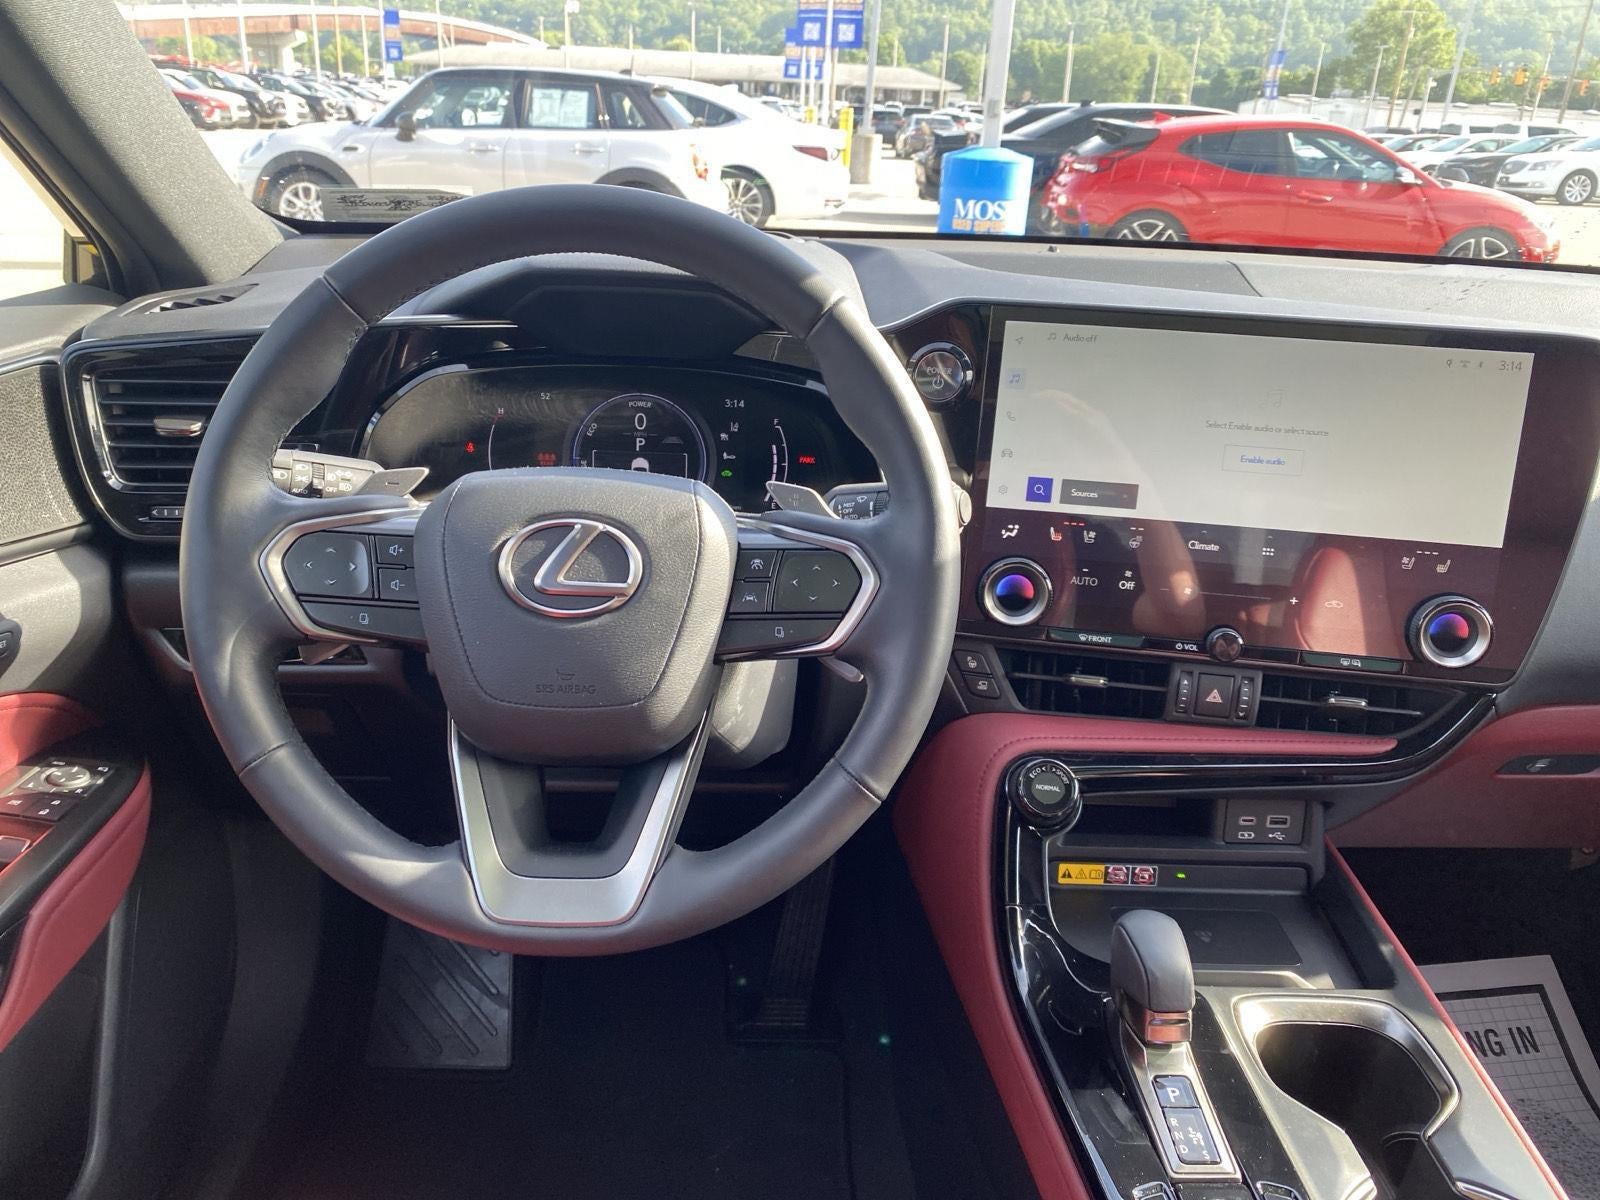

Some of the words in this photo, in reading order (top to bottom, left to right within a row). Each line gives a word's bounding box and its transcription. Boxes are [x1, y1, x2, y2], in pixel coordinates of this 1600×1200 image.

[1063, 333, 1085, 342] Audio
[1086, 335, 1097, 343] off
[1499, 360, 1522, 371] 3:14
[926, 366, 953, 376] POWER
[540, 392, 551, 400] 52
[628, 401, 652, 409] POWER
[724, 399, 745, 408] 3:14
[498, 407, 504, 415] H
[634, 412, 647, 431] 0
[586, 422, 598, 437] ECO
[1205, 420, 1228, 430] Select
[1228, 422, 1253, 431] Enable
[1283, 427, 1305, 435] select
[635, 437, 646, 452] P
[1239, 454, 1265, 465] Enable
[1265, 458, 1286, 466] audio
[292, 487, 308, 495] AUTO
[1071, 488, 1098, 498] Sources
[771, 502, 778, 510] E
[1188, 540, 1220, 552] Climate
[1070, 575, 1098, 587] AUTO
[1118, 580, 1136, 591] Off
[1088, 635, 1113, 643] FRONT
[1184, 643, 1199, 652] VOL
[535, 684, 554, 694] SRS
[555, 684, 597, 695] AIRBAG
[1029, 767, 1041, 779] ECO
[1035, 784, 1061, 793] NORMAL
[1507, 1025, 1541, 1055] IN
[1166, 1087, 1180, 1103] P
[1169, 1117, 1180, 1127] R
[1174, 1131, 1185, 1141] N
[1179, 1144, 1189, 1154] D
[1202, 1150, 1210, 1160] S
